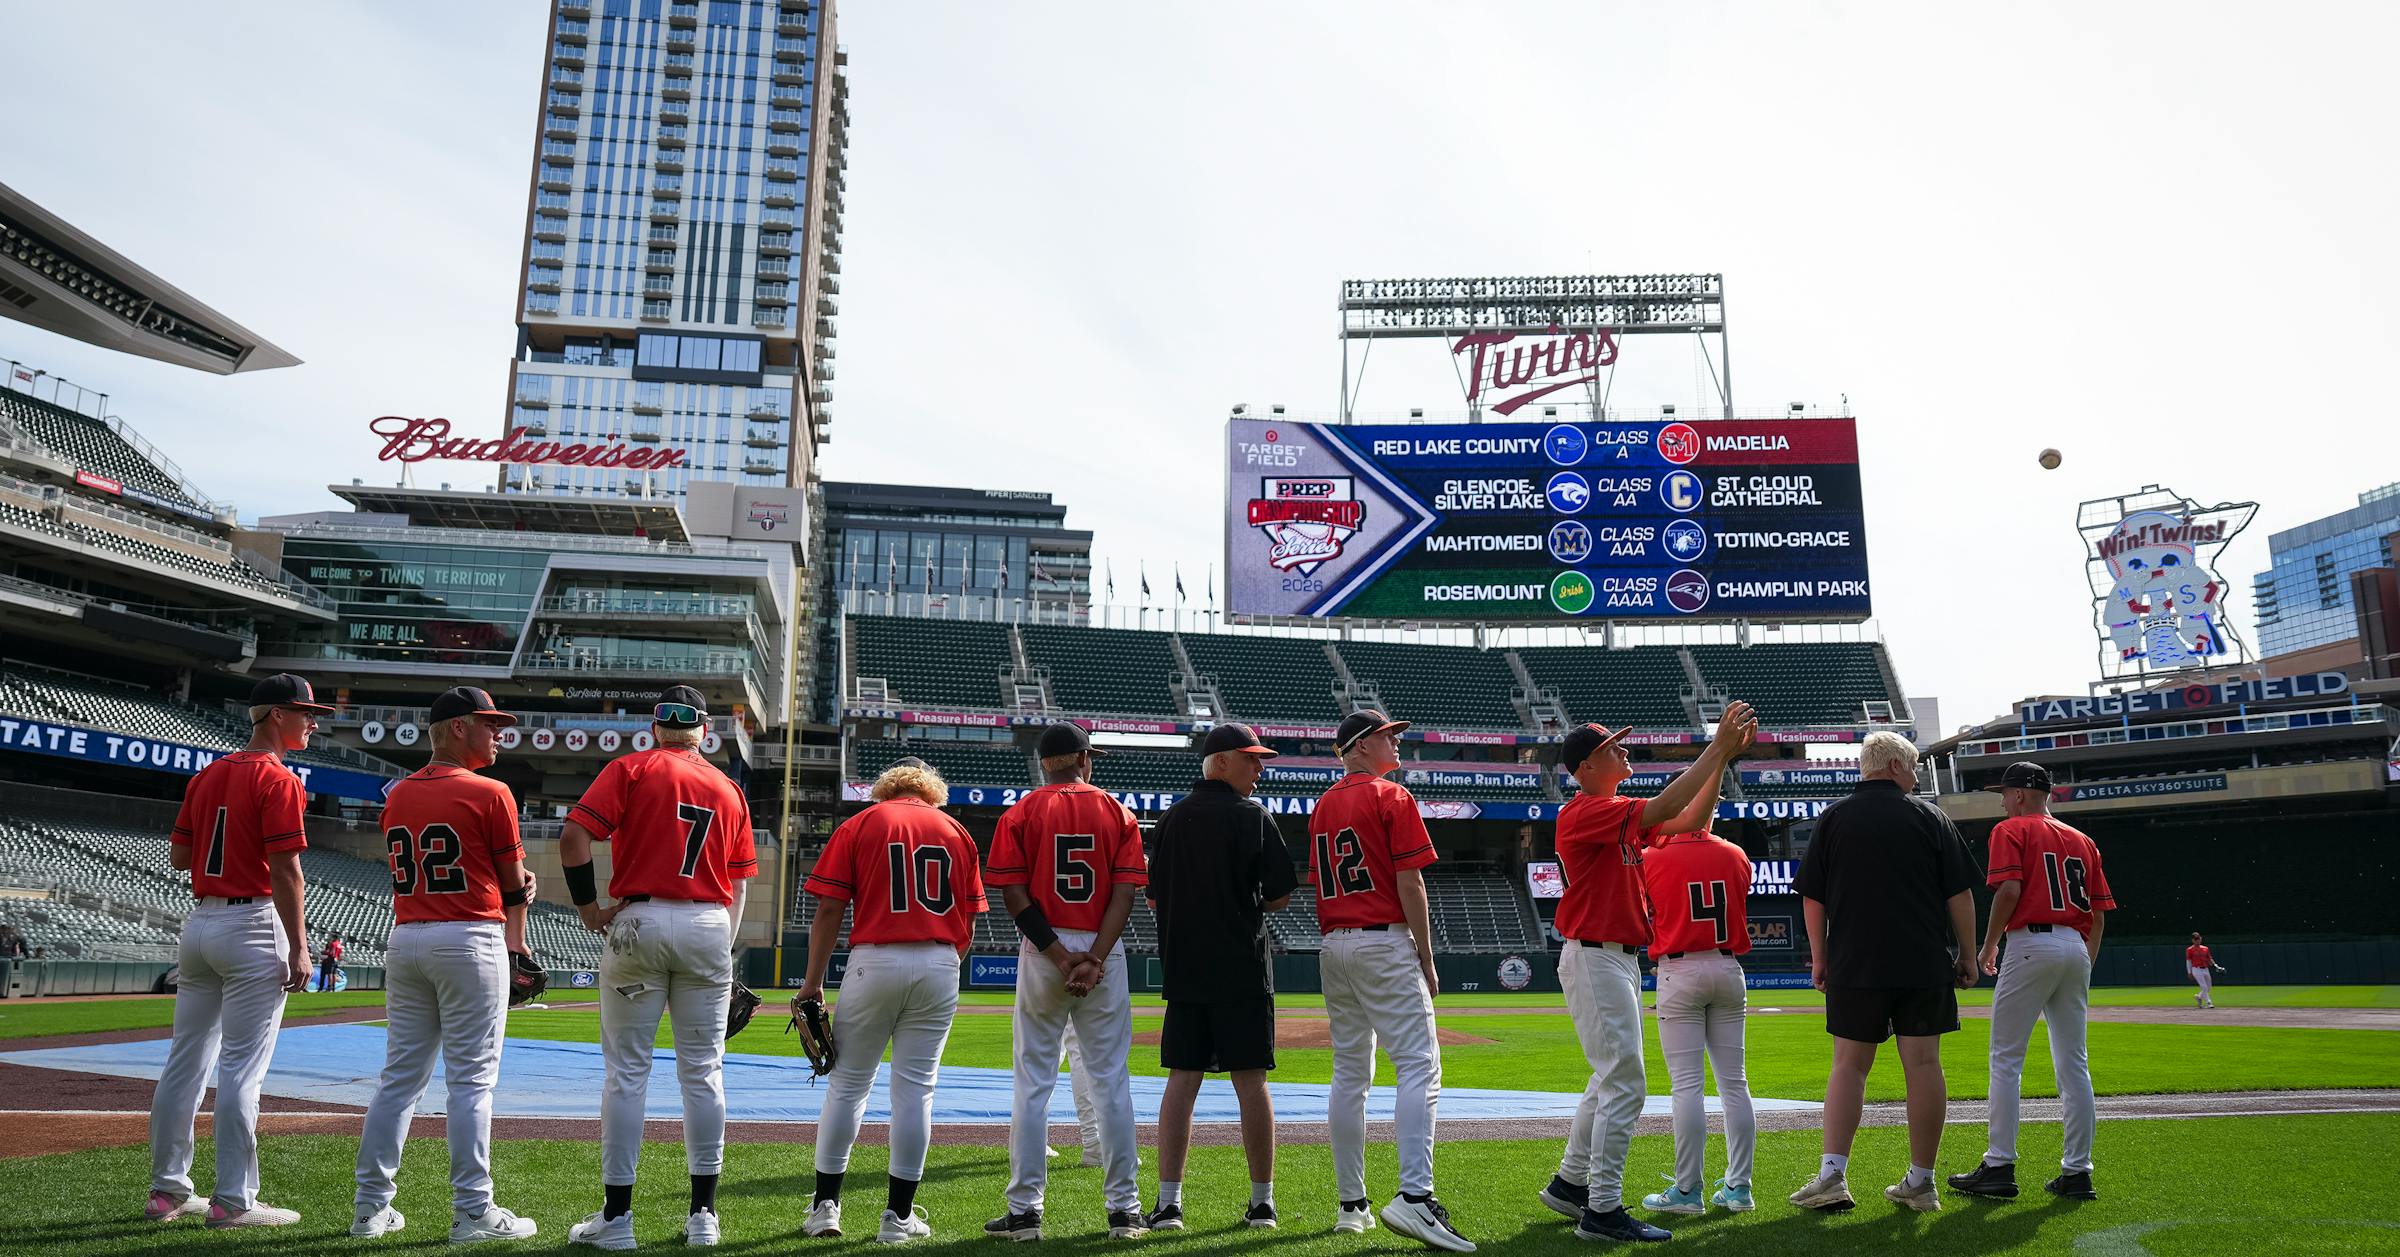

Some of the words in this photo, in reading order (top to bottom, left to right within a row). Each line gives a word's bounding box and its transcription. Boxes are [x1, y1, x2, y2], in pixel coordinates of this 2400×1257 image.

[1454, 323, 1618, 402] Twins
[369, 415, 685, 471] Budweiser
[1596, 431, 1649, 445] CLASS
[1706, 435, 1790, 452] MADELIA
[1239, 442, 1306, 457] TARGET
[1374, 440, 1410, 456] RED
[1415, 439, 1460, 455] LAKE
[1466, 438, 1541, 454] COUNTY
[1616, 446, 1629, 459] A
[1247, 454, 1298, 467] FIELD
[1277, 481, 1333, 497] PREP
[1443, 479, 1536, 495] GLENCOE-
[1598, 478, 1652, 492] CLASS
[1717, 476, 1745, 491] ST.
[1750, 475, 1813, 491] CLOUD
[1671, 474, 1692, 508] C
[1711, 490, 1822, 506] CATHEDRAL
[1435, 495, 1495, 510] SILVER
[1499, 494, 1545, 509] LAKE
[1613, 493, 1637, 507] AA
[1554, 528, 1587, 556] M
[1601, 527, 1654, 542] CLASS
[1714, 531, 1850, 549] TOTINO-GRACE
[2095, 526, 2147, 560] Win!
[2150, 516, 2228, 544] Twins!
[1426, 535, 1543, 551] MAHTOMEDI
[1610, 542, 1646, 556] AAA
[310, 566, 352, 580] WELCOME
[380, 567, 425, 586] TWINS
[434, 569, 507, 587] TERRITORY
[1282, 578, 1323, 593] 2026
[1558, 582, 1584, 599] Irish
[1603, 577, 1657, 592] CLASS
[1717, 581, 1813, 598] CHAMPLIN
[1818, 580, 1868, 597] PARK
[1424, 584, 1545, 601] ROSEMOUNT
[1607, 592, 1654, 607] AAAA
[2117, 586, 2133, 600] M
[2179, 584, 2196, 605] S
[350, 623, 368, 640] WE
[371, 624, 395, 641] ARE
[396, 625, 418, 641] ALL
[565, 686, 602, 698] Surfside
[604, 690, 620, 698] ICED
[2021, 688, 2175, 722] TARGET
[2219, 671, 2349, 705] FIELD
[912, 712, 961, 725] Treasure
[963, 713, 997, 726] Island
[368, 726, 380, 739] W
[400, 727, 415, 740] 42
[503, 732, 515, 743] 10
[537, 734, 550, 745] 28
[570, 735, 583, 745] 34
[1260, 727, 1304, 738] Treasure
[1306, 728, 1337, 739] Island
[1650, 734, 1681, 744] Island
[604, 736, 615, 746] 14
[706, 738, 713, 748] 3
[1266, 769, 1327, 782] Treasure
[1433, 772, 1472, 786] Home
[1475, 773, 1501, 786] Run
[1504, 774, 1537, 787] Deck
[1790, 772, 1833, 784] Home
[1835, 771, 1862, 783] Run
[2089, 784, 2131, 798] DELTA
[2186, 777, 2223, 790] SUITE
[205, 806, 227, 877] 1
[677, 801, 716, 879] 7
[386, 823, 468, 896] 32
[1315, 826, 1376, 900] 12
[1054, 833, 1096, 903] 5
[887, 842, 956, 917] 10
[2042, 851, 2092, 913] 18
[1688, 880, 1729, 944] 4
[574, 974, 593, 985] Ford
[788, 977, 806, 986] 339
[1461, 982, 1479, 991] 377
[1756, 977, 1779, 988] great
